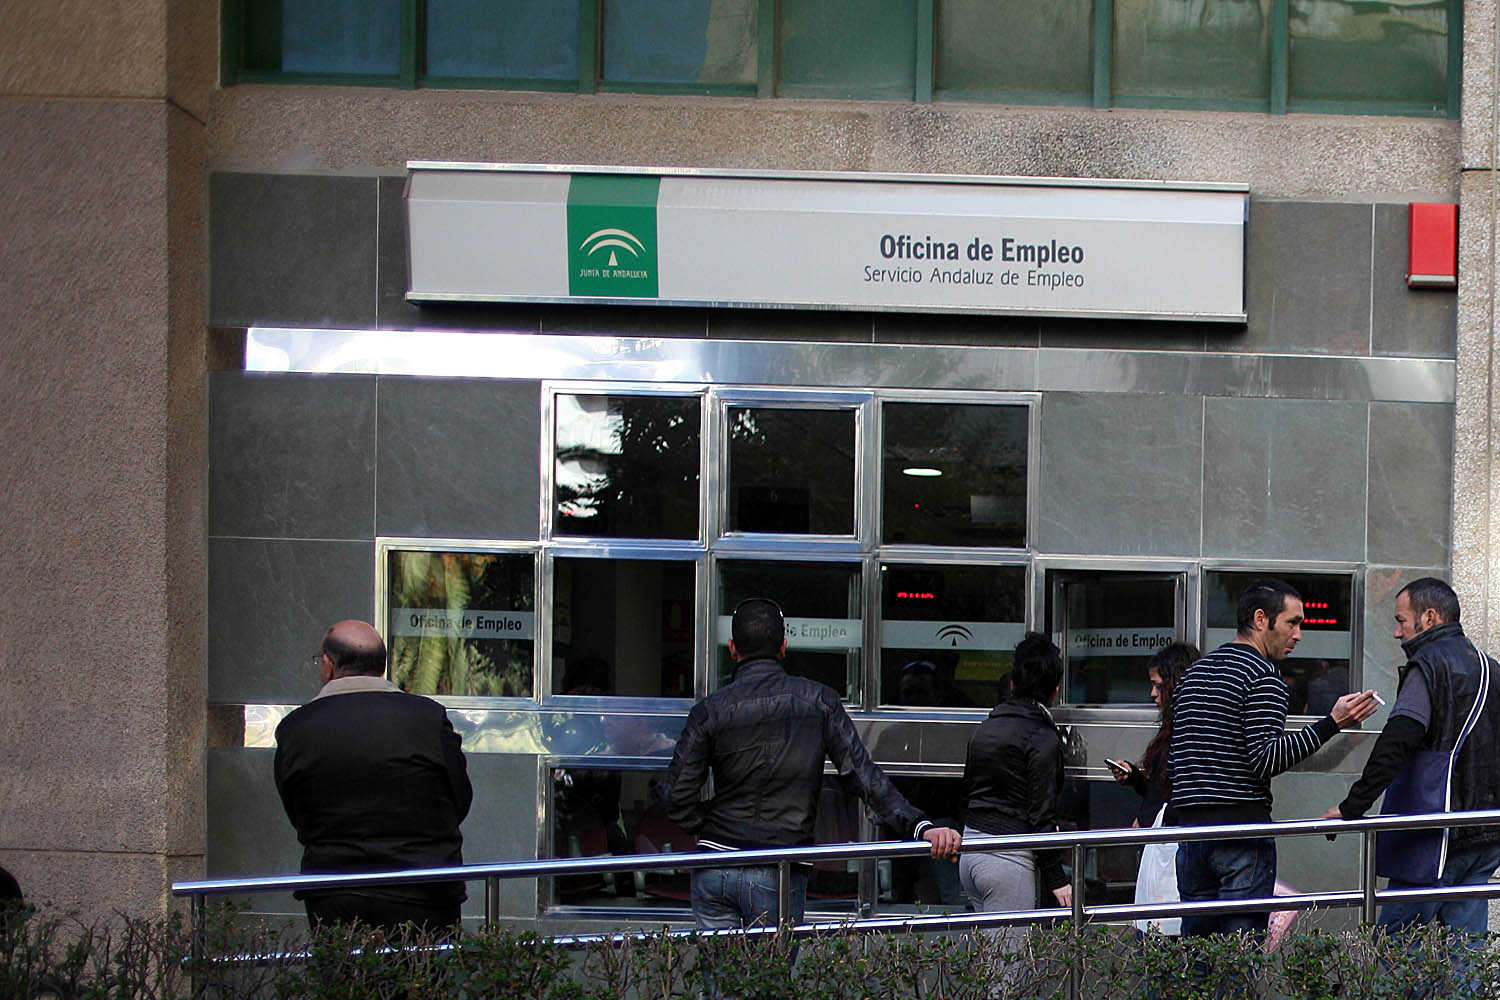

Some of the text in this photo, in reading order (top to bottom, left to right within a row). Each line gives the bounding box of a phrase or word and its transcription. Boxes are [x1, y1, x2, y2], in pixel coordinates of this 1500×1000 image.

[880, 234, 1084, 268] Oficina de Empleo
[579, 269, 600, 277] JUNTA
[602, 270, 610, 278] DE
[864, 265, 1084, 290] Servicio Andaluz de Empleo
[476, 616, 522, 632] Empleo
[801, 624, 847, 640] Empleo
[1116, 634, 1128, 648] de
[1132, 634, 1172, 650] Empleo
